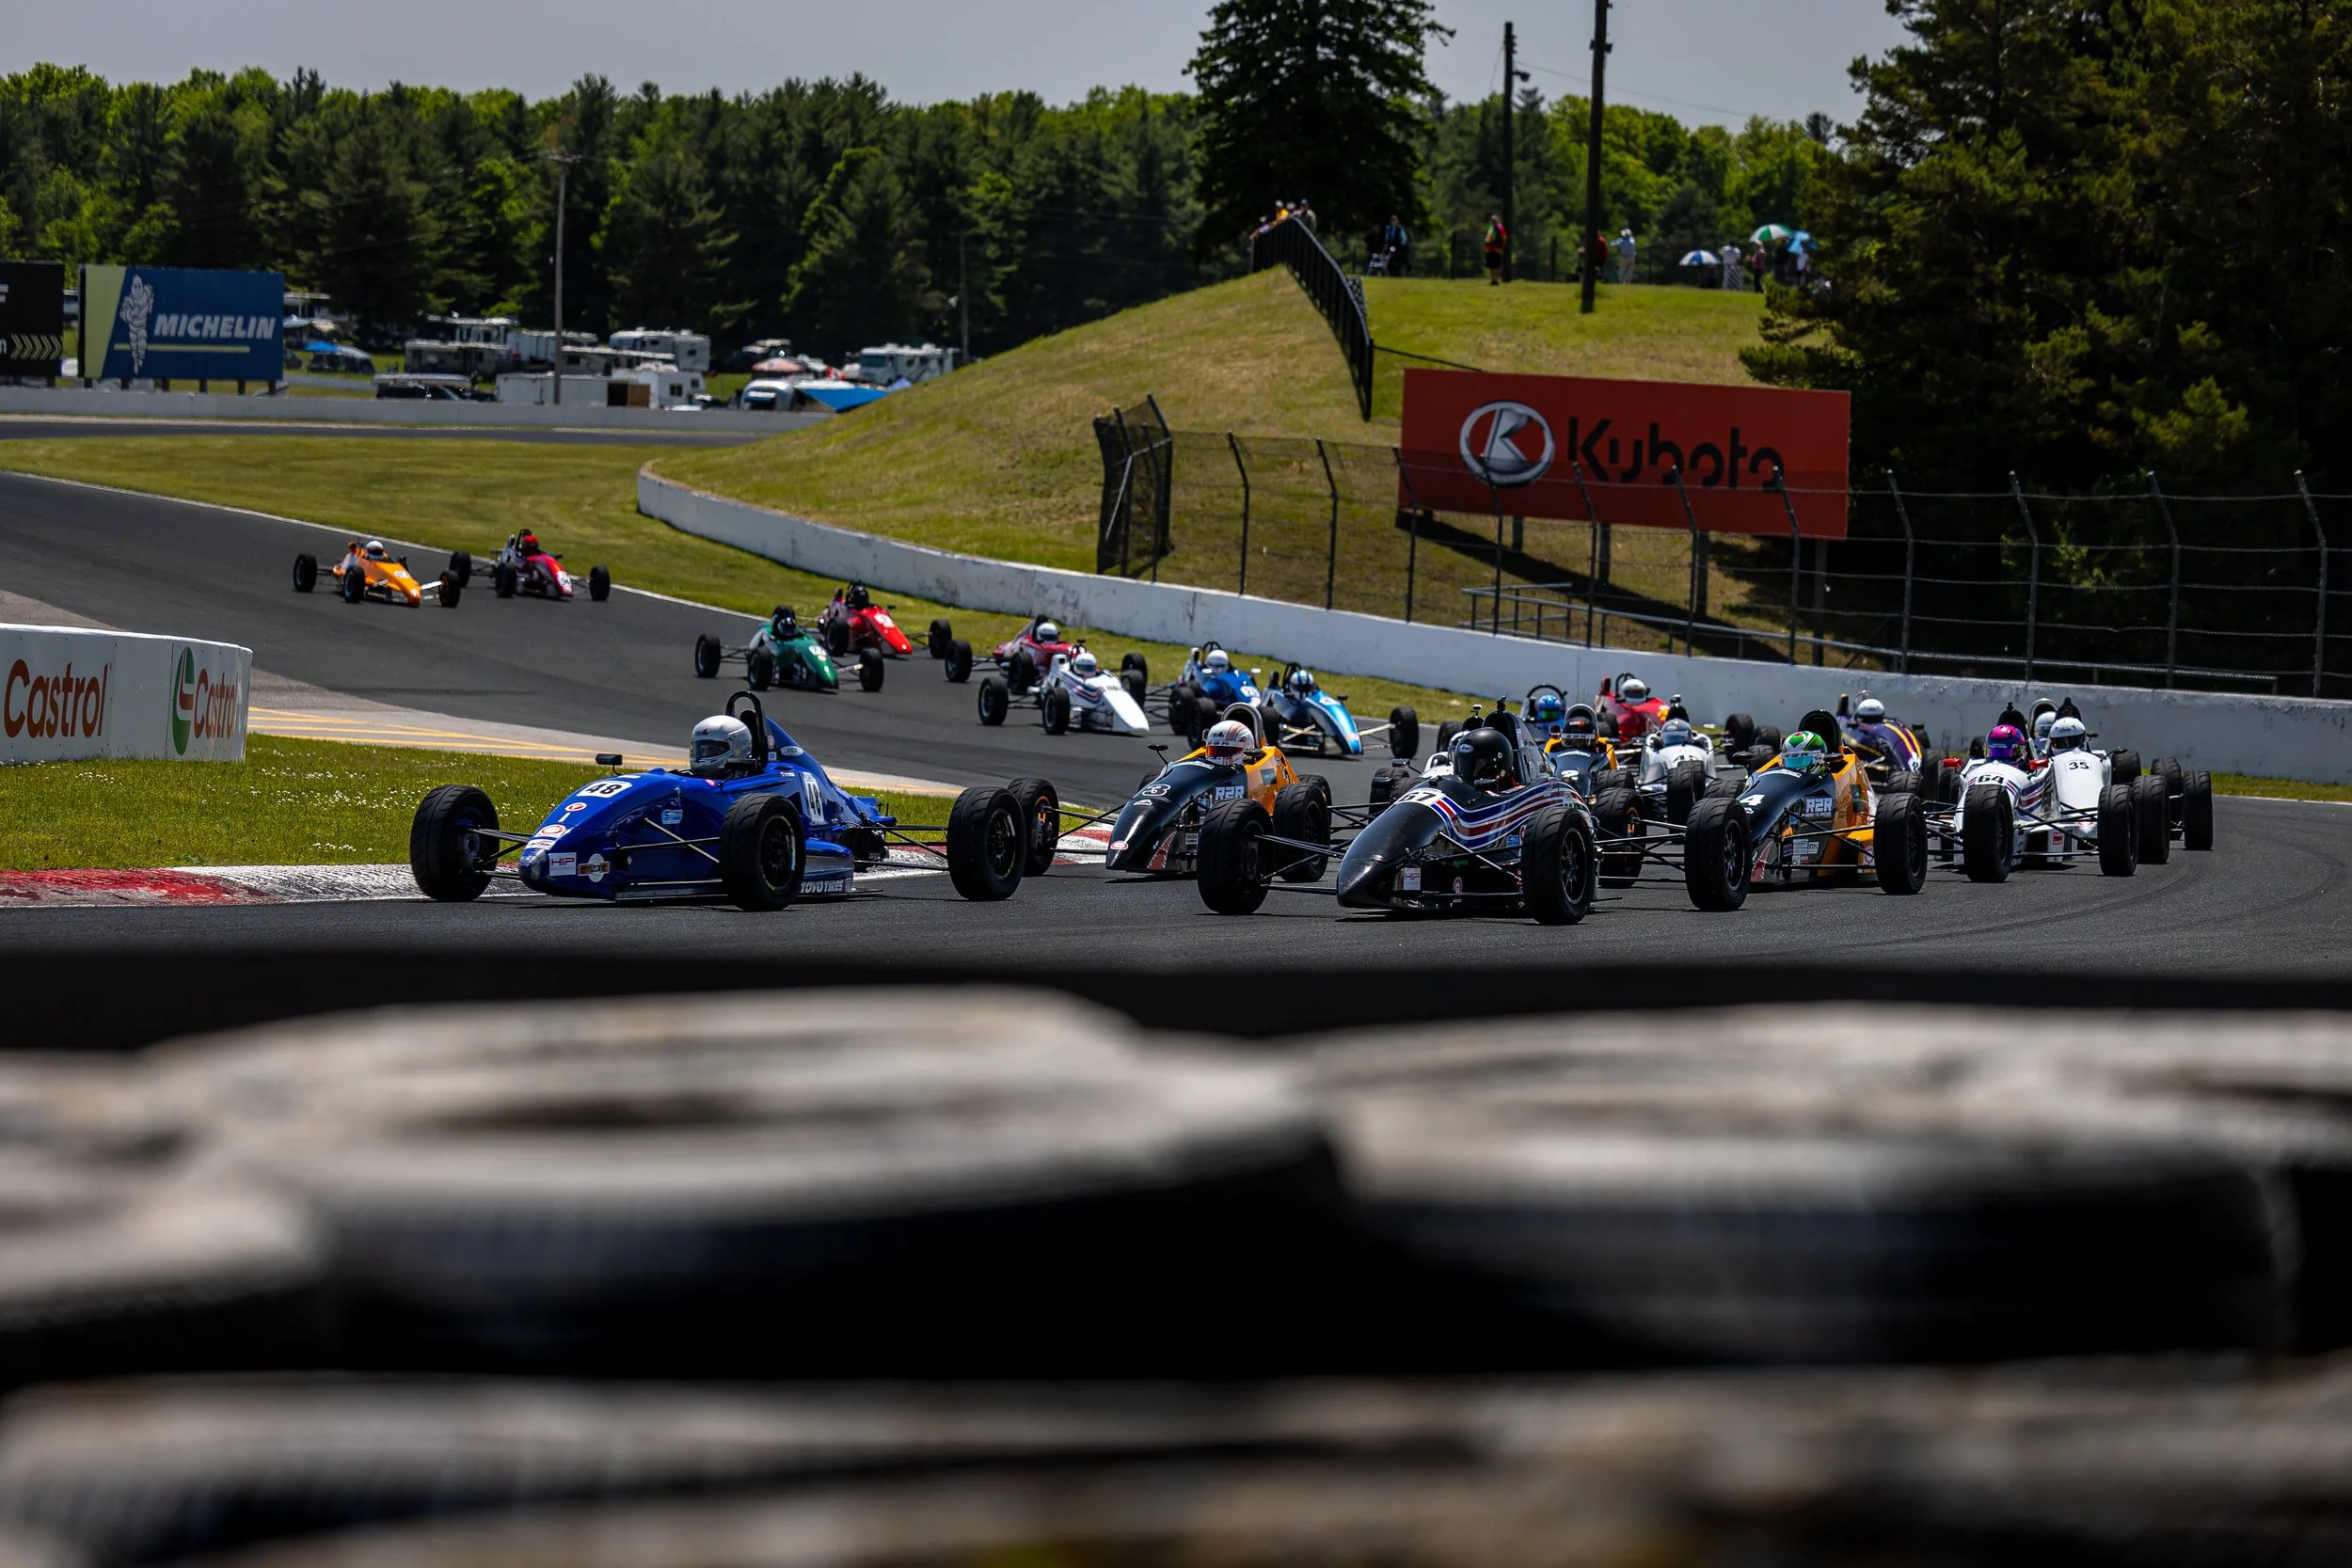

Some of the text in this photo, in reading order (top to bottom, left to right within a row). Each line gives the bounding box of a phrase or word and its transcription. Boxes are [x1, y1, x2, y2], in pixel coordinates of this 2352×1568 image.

[153, 312, 276, 341] MICHELIN
[1567, 417, 1786, 494] Kubota
[4, 658, 109, 739] Castrol
[194, 668, 239, 739] Castrol
[2069, 761, 2090, 770] 35
[1978, 774, 2004, 784] 64
[585, 783, 623, 796] 48
[1215, 785, 1245, 800] R2R
[1398, 791, 1437, 802] 67
[806, 783, 822, 816] 48
[1740, 794, 1765, 807] 4
[1805, 798, 1833, 813] R2R
[551, 857, 575, 866] HIP
[1405, 872, 1420, 880] HIP
[800, 879, 844, 894] TOYO TIRES
